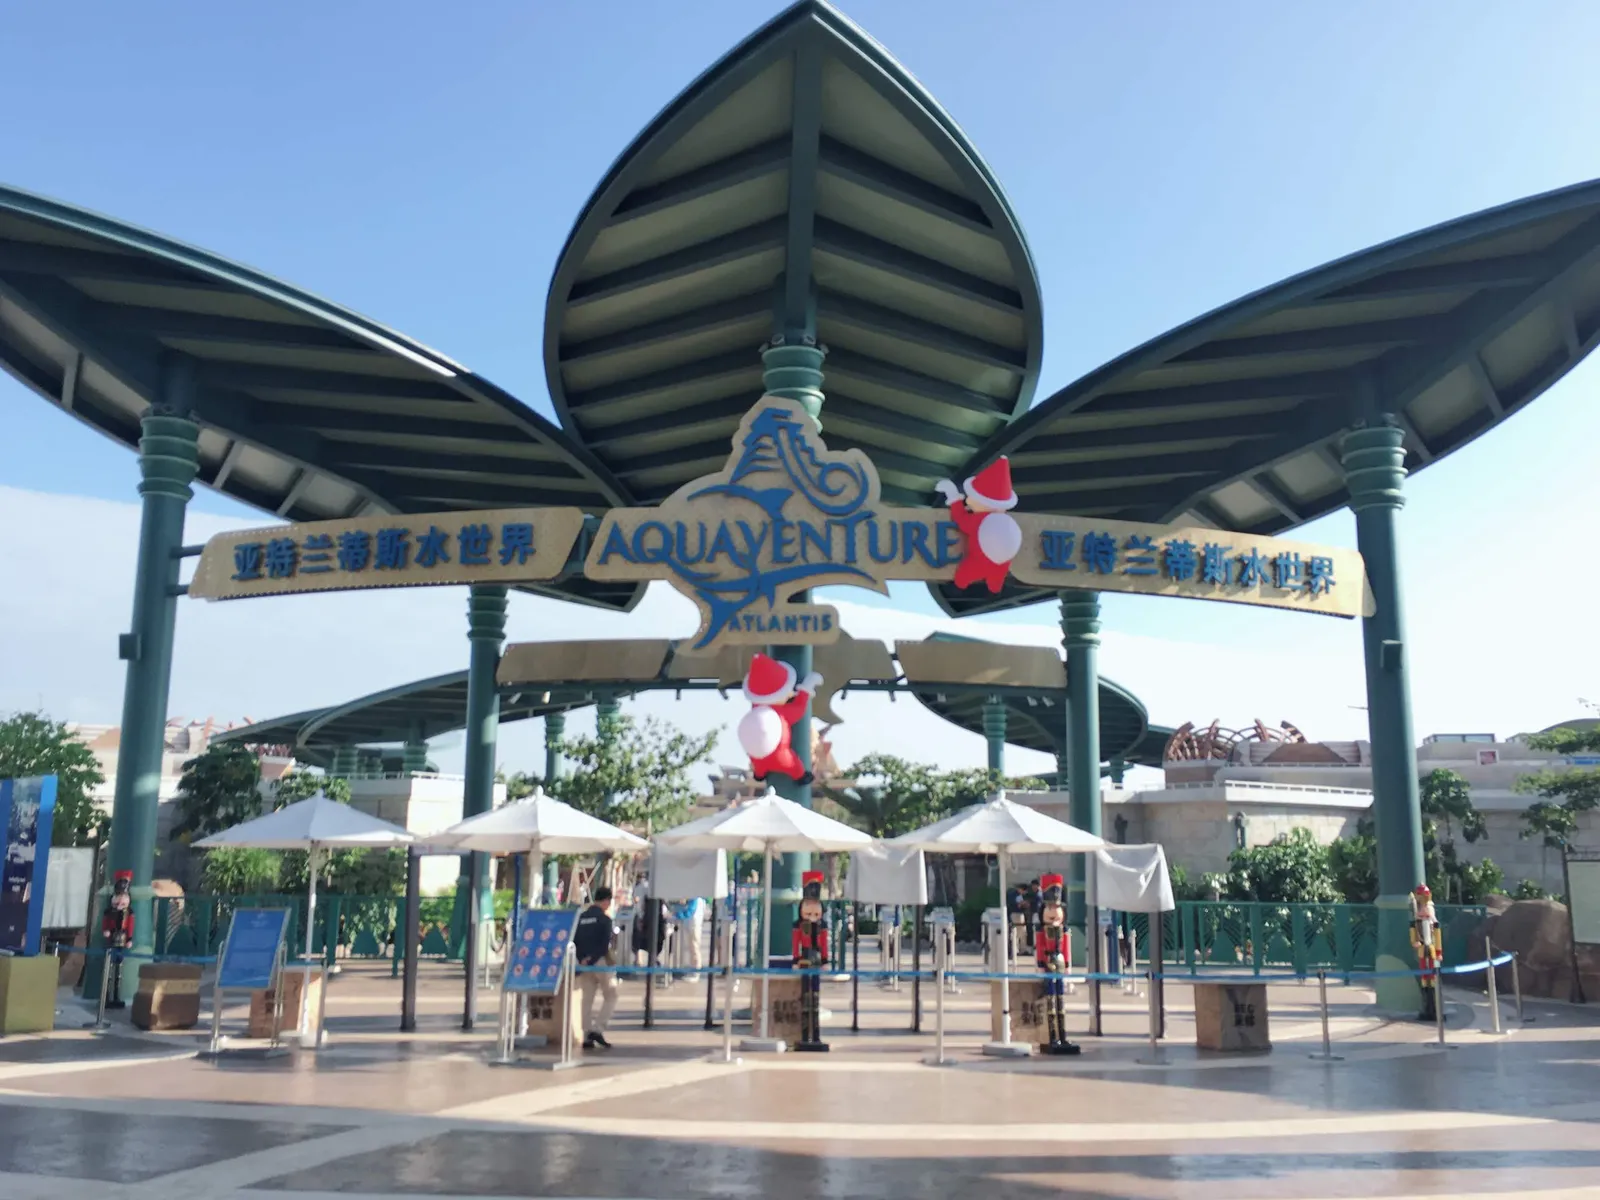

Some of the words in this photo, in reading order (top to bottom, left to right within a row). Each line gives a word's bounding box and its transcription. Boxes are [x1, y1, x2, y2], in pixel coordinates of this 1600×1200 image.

[232, 522, 536, 580] 亚特兰蒂斯水世界
[597, 512, 963, 569] AQUAVENTURE
[1040, 530, 1336, 594] 亚特兰蒂斯水世界
[728, 613, 833, 633] ATLANTIS
